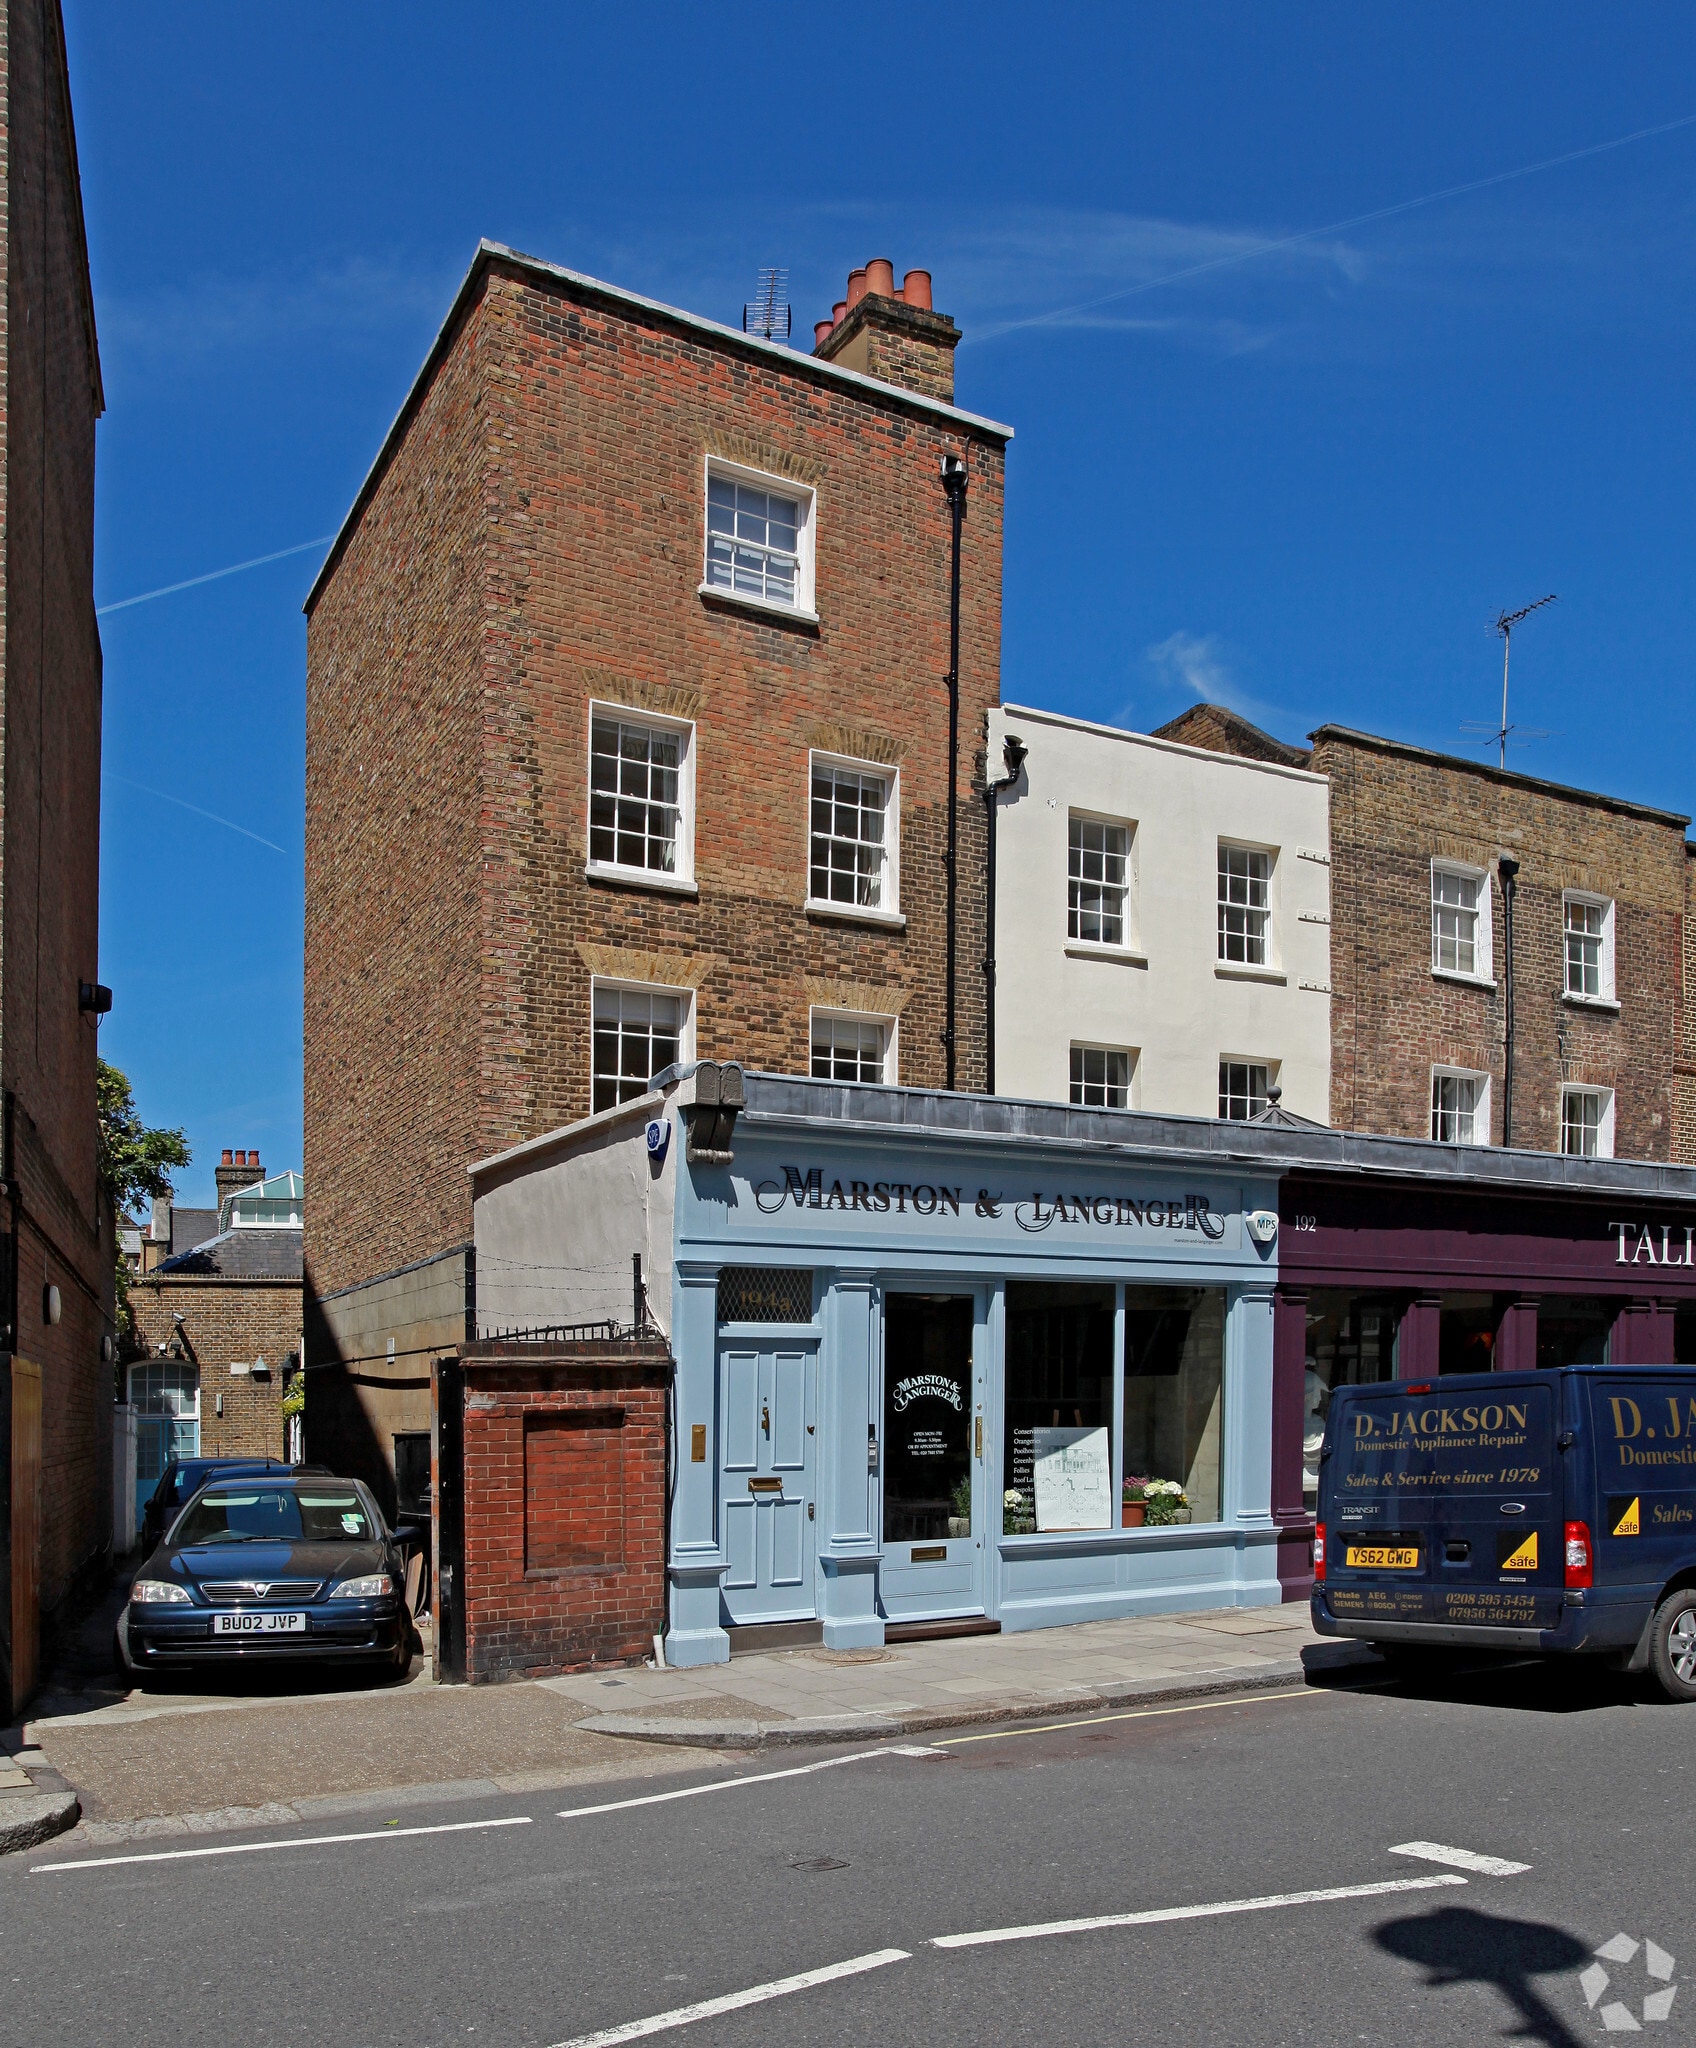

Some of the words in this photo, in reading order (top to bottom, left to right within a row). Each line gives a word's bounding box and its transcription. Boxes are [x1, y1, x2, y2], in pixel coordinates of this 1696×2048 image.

[756, 1166, 964, 1217] MARSTON
[974, 1188, 1003, 1219] &
[1015, 1193, 1225, 1240] LANGINGER
[1256, 1218, 1276, 1230] MPS
[1295, 1215, 1317, 1233] 192
[1608, 1222, 1696, 1266] TALI
[740, 1289, 791, 1313] 194a
[893, 1374, 951, 1399] MARSTON
[949, 1381, 962, 1393] &
[894, 1386, 963, 1411] LANGINGER
[1354, 1415, 1381, 1438] D.
[1386, 1404, 1528, 1436] JACKSON
[1608, 1397, 1656, 1439] D.
[1013, 1438, 1041, 1446] Orangeries
[1355, 1438, 1409, 1452] Domestic
[1411, 1436, 1476, 1452] Appliance
[1479, 1432, 1527, 1449] Repair
[1344, 1473, 1379, 1488] Sales
[1381, 1472, 1393, 1486] &
[1396, 1471, 1450, 1486] Service
[1453, 1469, 1493, 1484] since
[1498, 1467, 1540, 1483] 1978
[1342, 1506, 1380, 1514] TRANSIT
[1652, 1504, 1693, 1523] Sales
[1618, 1522, 1638, 1533] safe
[1353, 1550, 1383, 1564] YS62
[1387, 1550, 1412, 1565] GWG
[1509, 1556, 1536, 1567] safe
[1333, 1591, 1361, 1599] Miele
[1446, 1593, 1476, 1605] 0208
[1477, 1594, 1500, 1606] 595
[1503, 1594, 1535, 1607] 5454
[1333, 1600, 1364, 1609] SIEMENS
[1449, 1607, 1486, 1619] 07956
[1488, 1608, 1535, 1621] 564797
[222, 1616, 263, 1630] BU02
[268, 1615, 298, 1629] JVP
